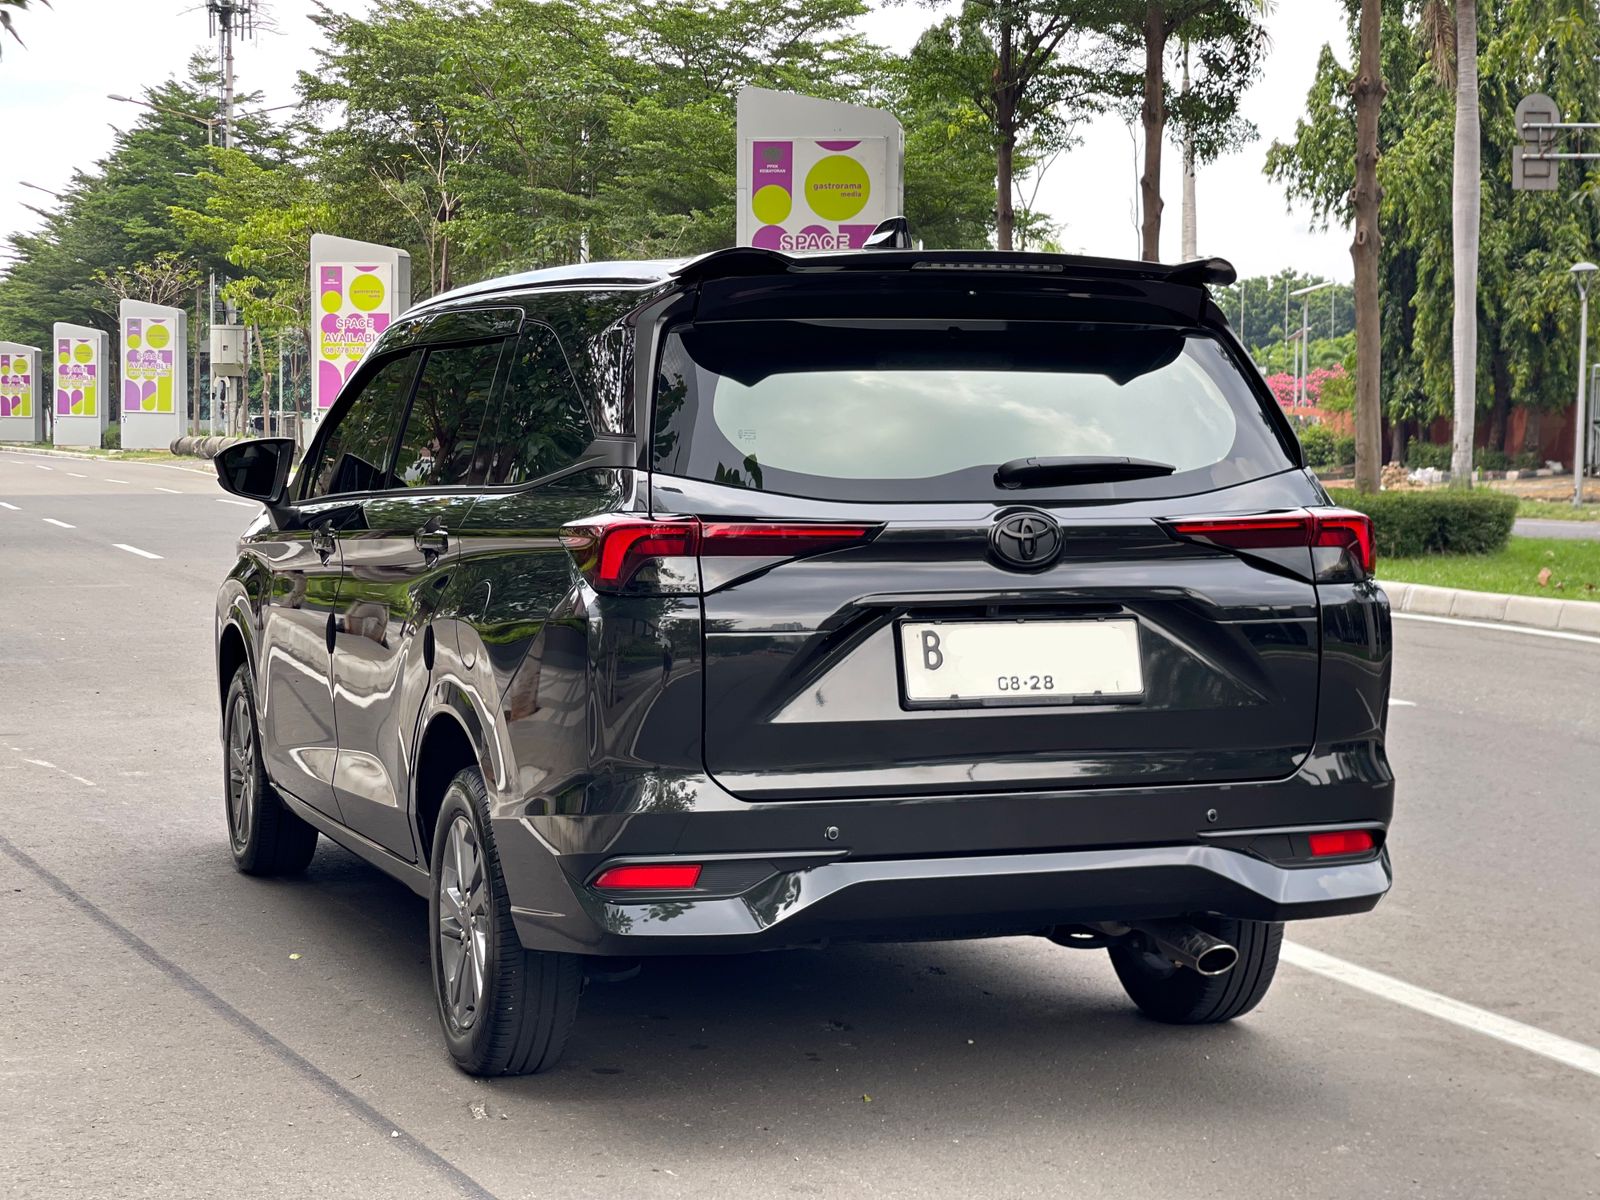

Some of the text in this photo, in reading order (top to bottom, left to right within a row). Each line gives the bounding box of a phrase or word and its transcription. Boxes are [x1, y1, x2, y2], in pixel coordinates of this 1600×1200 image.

[813, 181, 862, 191] gastrorama
[781, 234, 848, 250] SPACE
[336, 318, 374, 328] SPACE
[324, 333, 376, 342] AVAILABL
[921, 630, 943, 671] B
